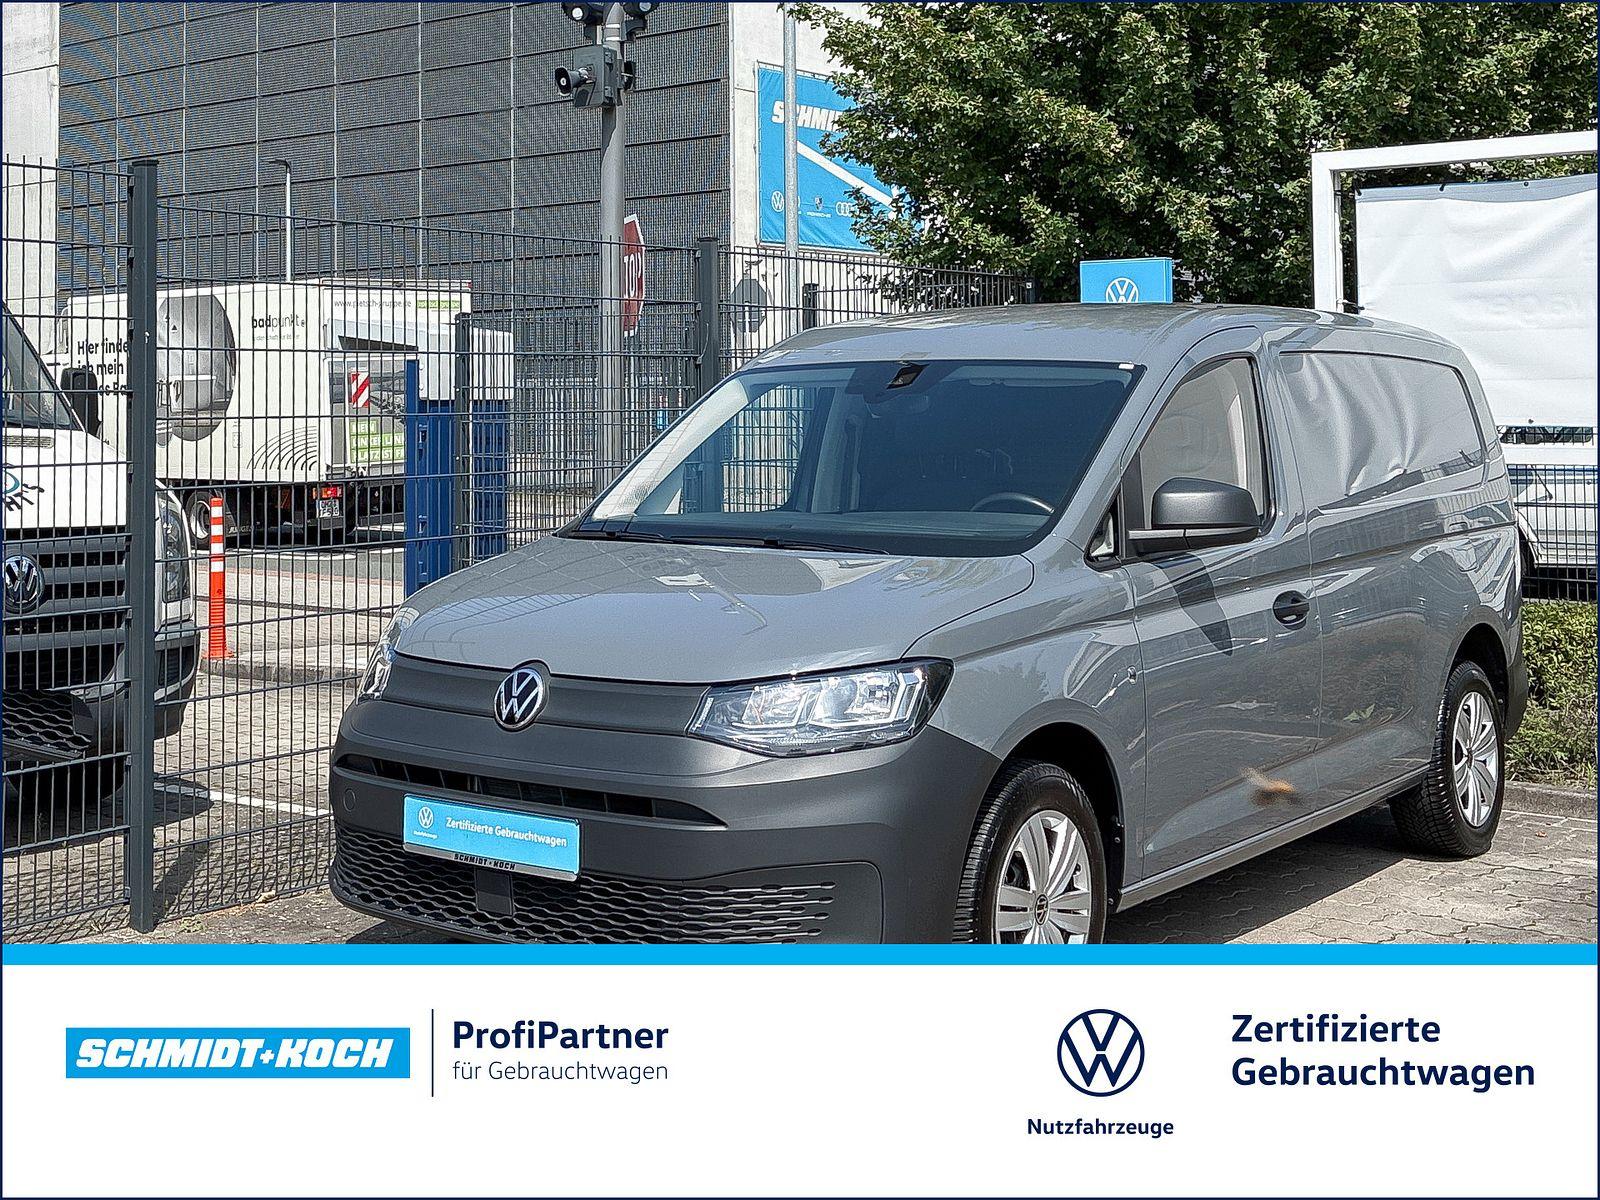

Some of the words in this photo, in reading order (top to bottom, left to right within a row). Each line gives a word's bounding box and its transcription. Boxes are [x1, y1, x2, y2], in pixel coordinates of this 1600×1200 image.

[623, 251, 642, 299] TOP
[446, 817, 493, 835] Zertifizierte
[495, 826, 567, 848] Gebrauchtwagen
